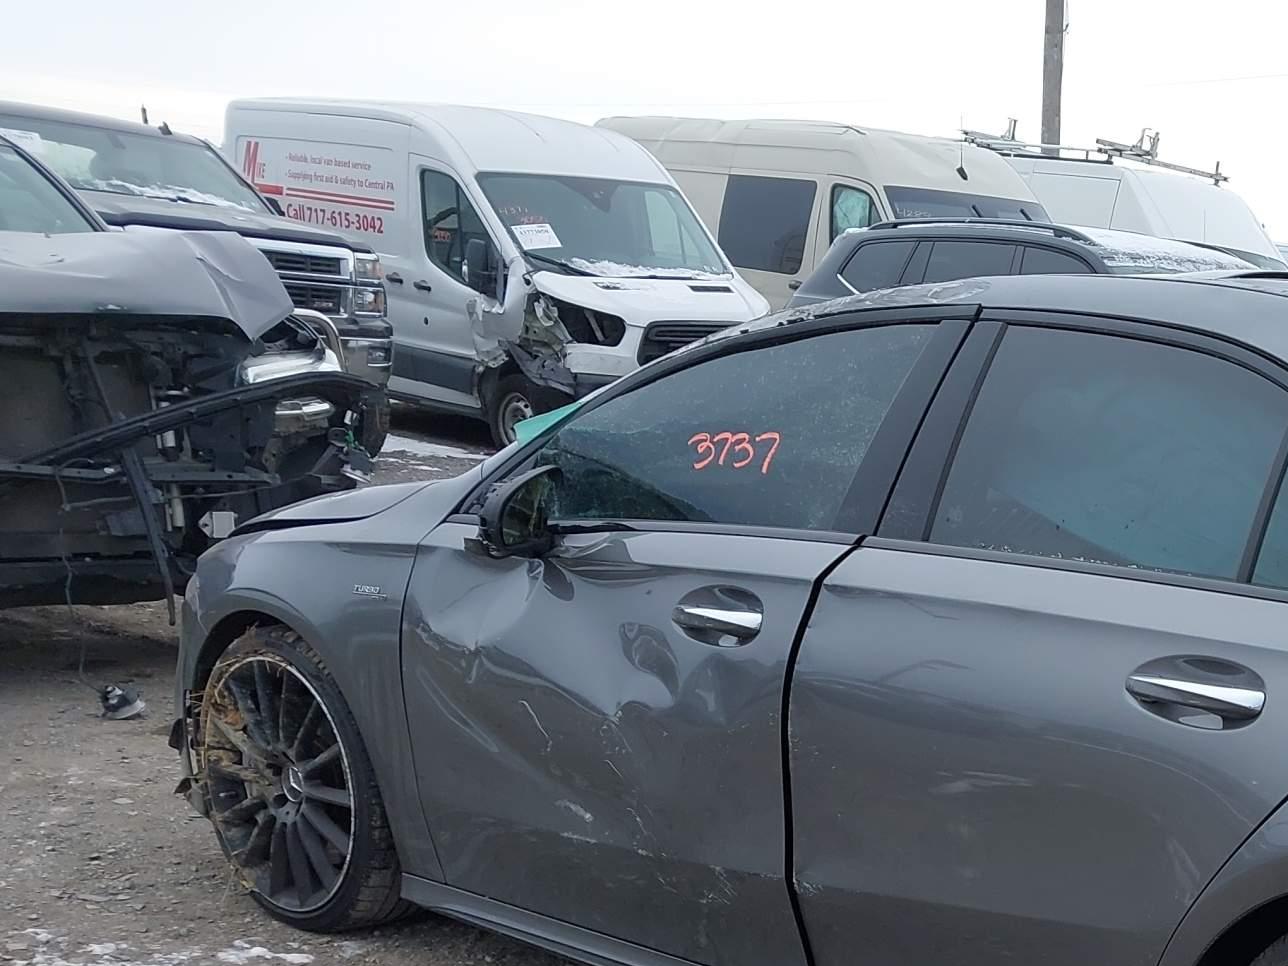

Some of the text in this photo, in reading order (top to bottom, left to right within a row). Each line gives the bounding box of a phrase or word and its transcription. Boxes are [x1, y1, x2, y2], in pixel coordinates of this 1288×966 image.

[334, 157, 351, 169] based
[351, 161, 371, 171] service
[287, 169, 312, 183] Supplying
[357, 178, 364, 187] to
[364, 179, 386, 190] Central
[386, 182, 395, 191] PA
[286, 203, 384, 234] Call 717-615-3042
[688, 431, 781, 475] 3737
